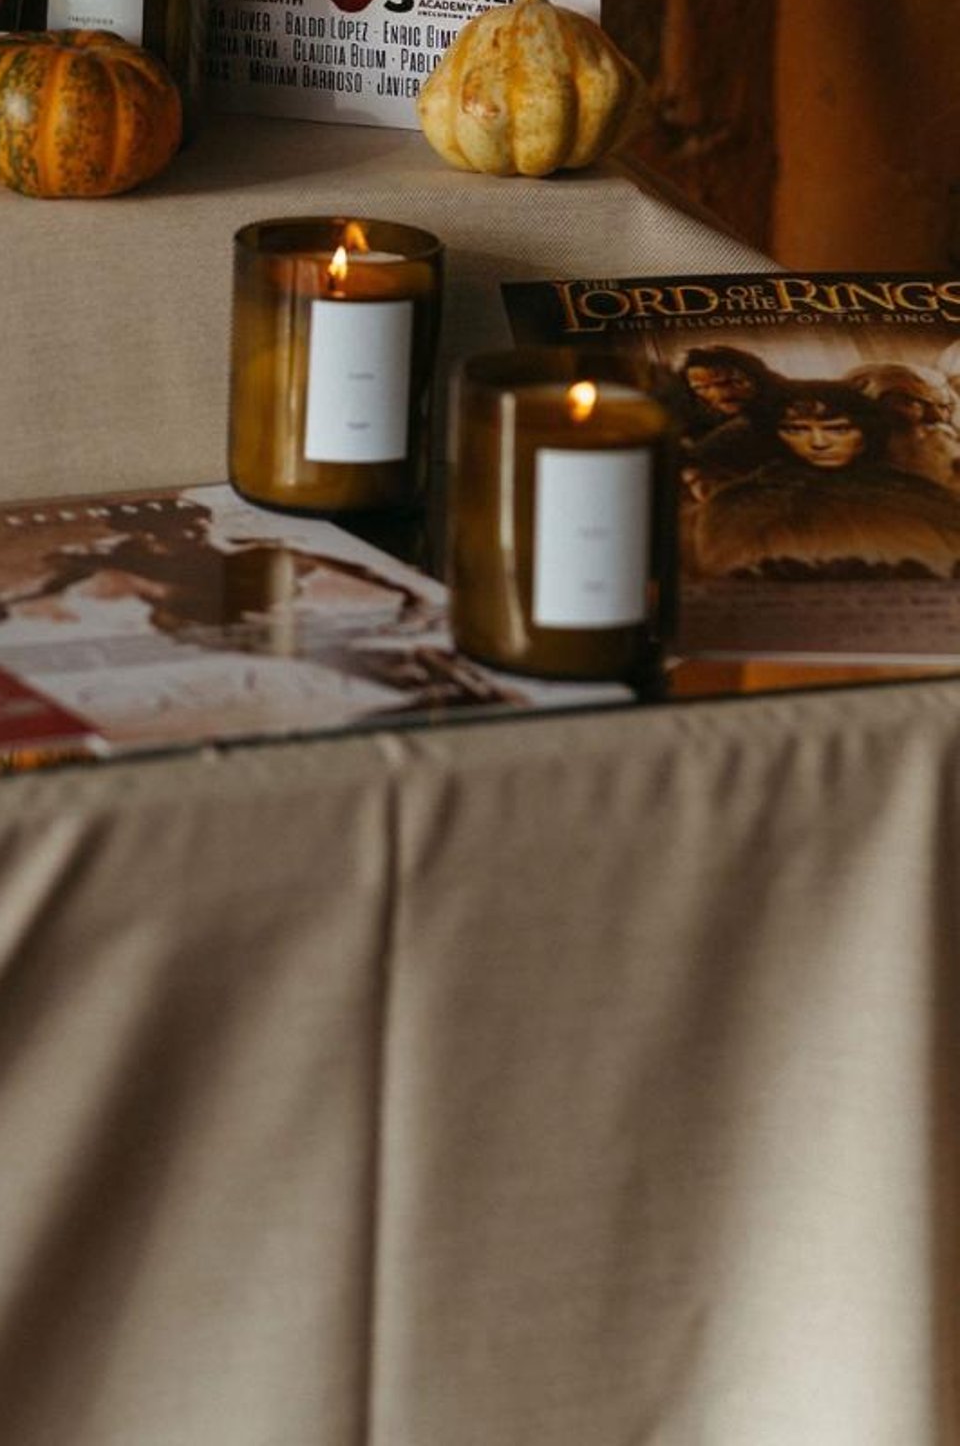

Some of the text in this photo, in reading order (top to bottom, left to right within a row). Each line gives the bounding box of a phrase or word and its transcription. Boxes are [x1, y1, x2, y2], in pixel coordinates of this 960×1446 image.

[419, 0, 473, 12] ACADEMY
[285, 12, 325, 38] BALDO
[329, 16, 368, 43] LÓPEZ
[383, 21, 421, 46] ENRIC
[293, 39, 346, 67] CLAUDIA
[351, 43, 386, 69] BLUM
[303, 66, 362, 94] BARROSO
[552, 279, 719, 332] LORD
[721, 296, 779, 311] THE
[726, 285, 764, 298] OF
[766, 278, 960, 322] RINGS
[664, 314, 787, 330] FELLOWSHIP
[796, 313, 823, 324] OF
[838, 313, 872, 324] THE
[883, 313, 935, 324] RING
